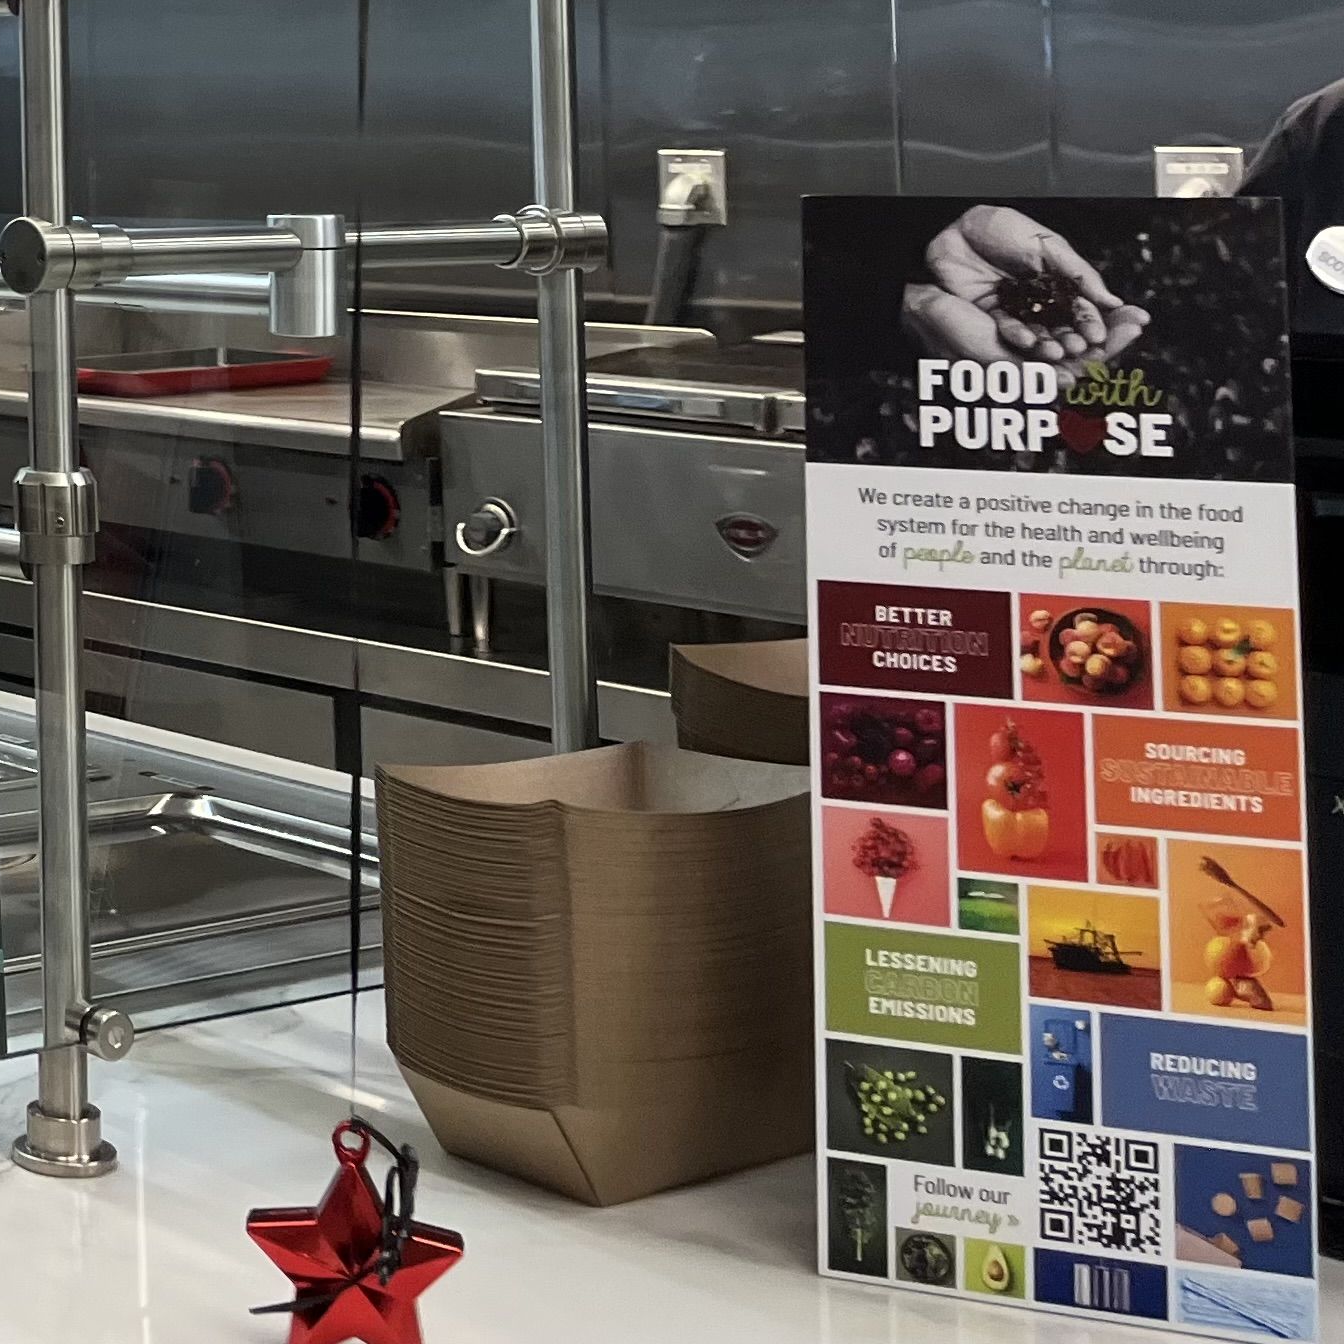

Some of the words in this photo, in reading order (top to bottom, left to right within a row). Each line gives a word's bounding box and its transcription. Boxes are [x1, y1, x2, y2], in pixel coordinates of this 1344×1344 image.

[918, 359, 1058, 404] FOOD
[1066, 361, 1163, 406] with
[919, 405, 1174, 457] PURPSE
[858, 487, 887, 505] We
[892, 492, 954, 508] create
[959, 496, 971, 510] a
[976, 495, 1052, 514] positive
[1057, 498, 1130, 521] change
[1135, 500, 1154, 519] in
[1159, 502, 1192, 520] the
[1198, 504, 1244, 523] food
[877, 518, 946, 536] system
[952, 519, 979, 536] for
[984, 521, 1015, 539] the
[1021, 522, 1082, 543] health
[1087, 527, 1124, 545] and
[1130, 530, 1225, 554] wellbeing
[878, 542, 898, 558] of
[903, 540, 976, 572] people
[980, 550, 1016, 566] and
[1022, 550, 1052, 568] the
[1059, 546, 1135, 579] planet
[1139, 556, 1225, 581] through:
[875, 605, 953, 627] BETTER
[840, 622, 989, 656] NUTRITION
[872, 651, 958, 673] CHOICES
[1144, 742, 1246, 766] SOURCING
[1099, 758, 1294, 796] SUSTAINABLE
[1129, 786, 1263, 814] INGREDIENTS
[865, 948, 977, 978] LESSENING
[864, 969, 979, 1006] CARBON
[868, 996, 976, 1026] EMISSIONS
[1150, 1052, 1258, 1081] REDUCING
[1151, 1073, 1259, 1111] WASTE
[913, 1174, 974, 1200] Follow
[979, 1188, 1012, 1205] our
[911, 1201, 1002, 1234] journey
